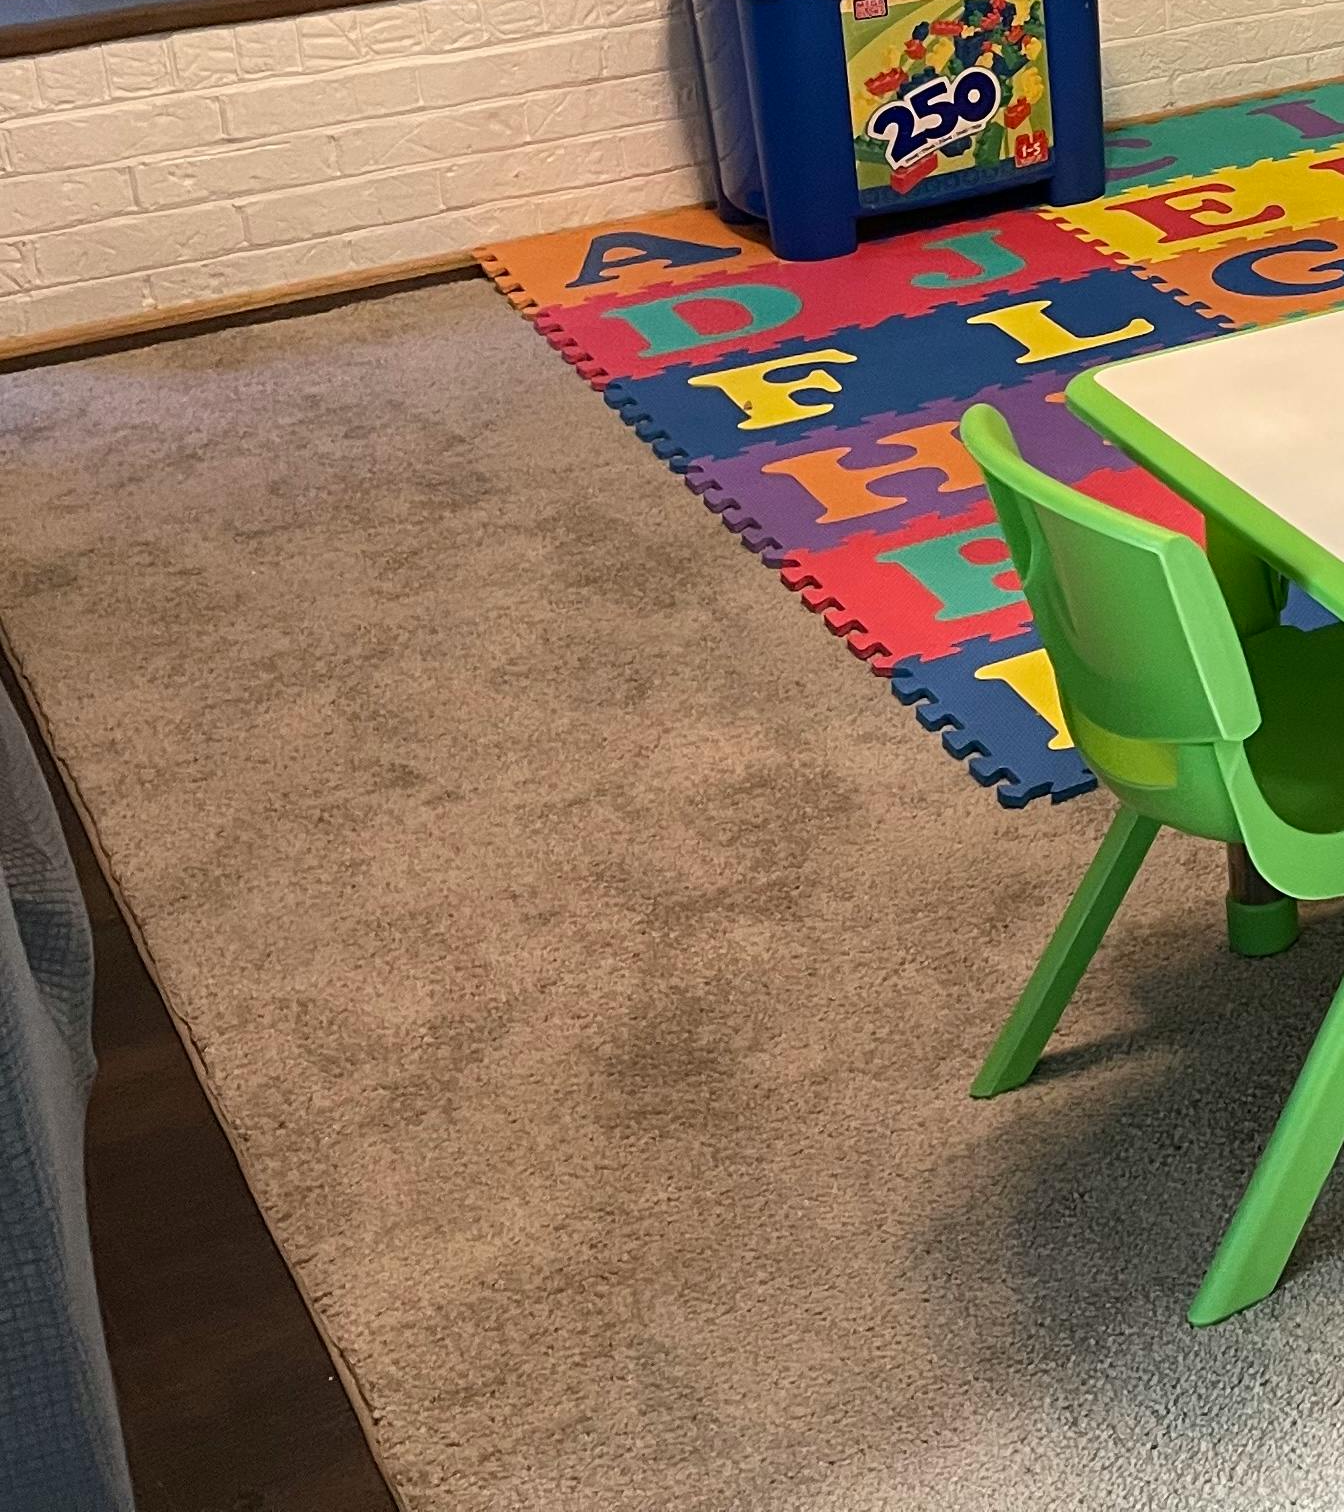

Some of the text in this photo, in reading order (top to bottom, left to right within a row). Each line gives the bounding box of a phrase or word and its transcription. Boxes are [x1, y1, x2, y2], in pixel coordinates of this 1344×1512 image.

[873, 71, 997, 163] 250
[1021, 144, 1042, 158] 1-5
[1105, 183, 1286, 244] E
[565, 231, 742, 288] A
[910, 229, 1028, 288] J
[601, 284, 802, 359] D
[966, 300, 1155, 364] L
[688, 349, 858, 430] F
[761, 420, 986, 524] H
